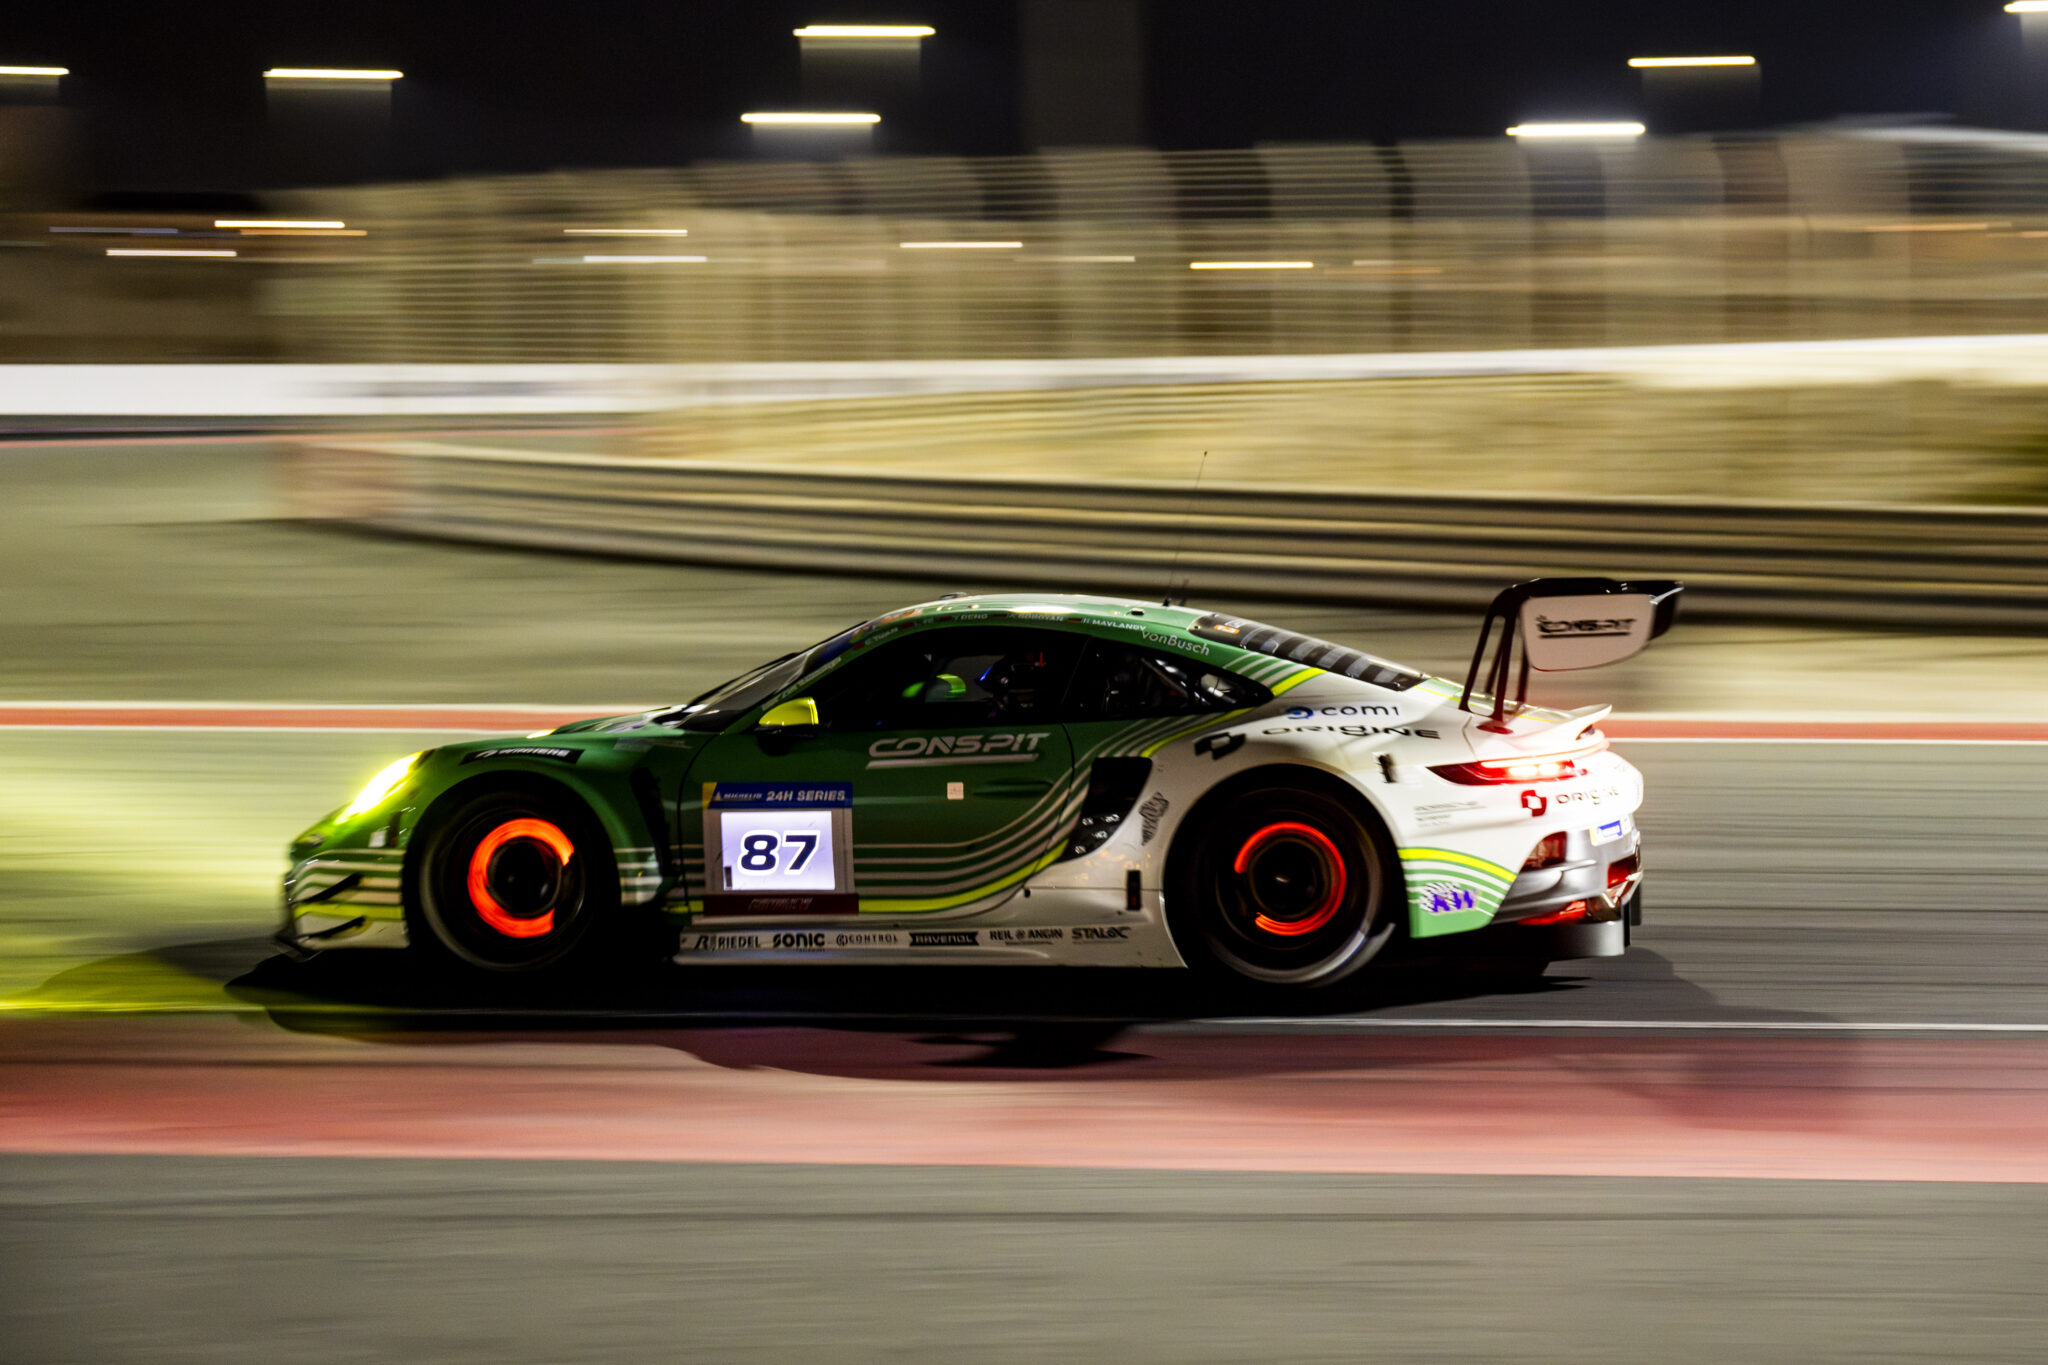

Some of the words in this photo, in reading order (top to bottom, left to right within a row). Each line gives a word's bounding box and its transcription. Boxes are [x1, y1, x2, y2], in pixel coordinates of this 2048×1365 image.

[1141, 630, 1210, 657] vonBusch
[868, 732, 1051, 758] CONSPIT
[765, 790, 794, 802] 24H
[796, 790, 846, 802] SERIES
[739, 832, 819, 873] 87
[718, 935, 760, 949] RIEDEL
